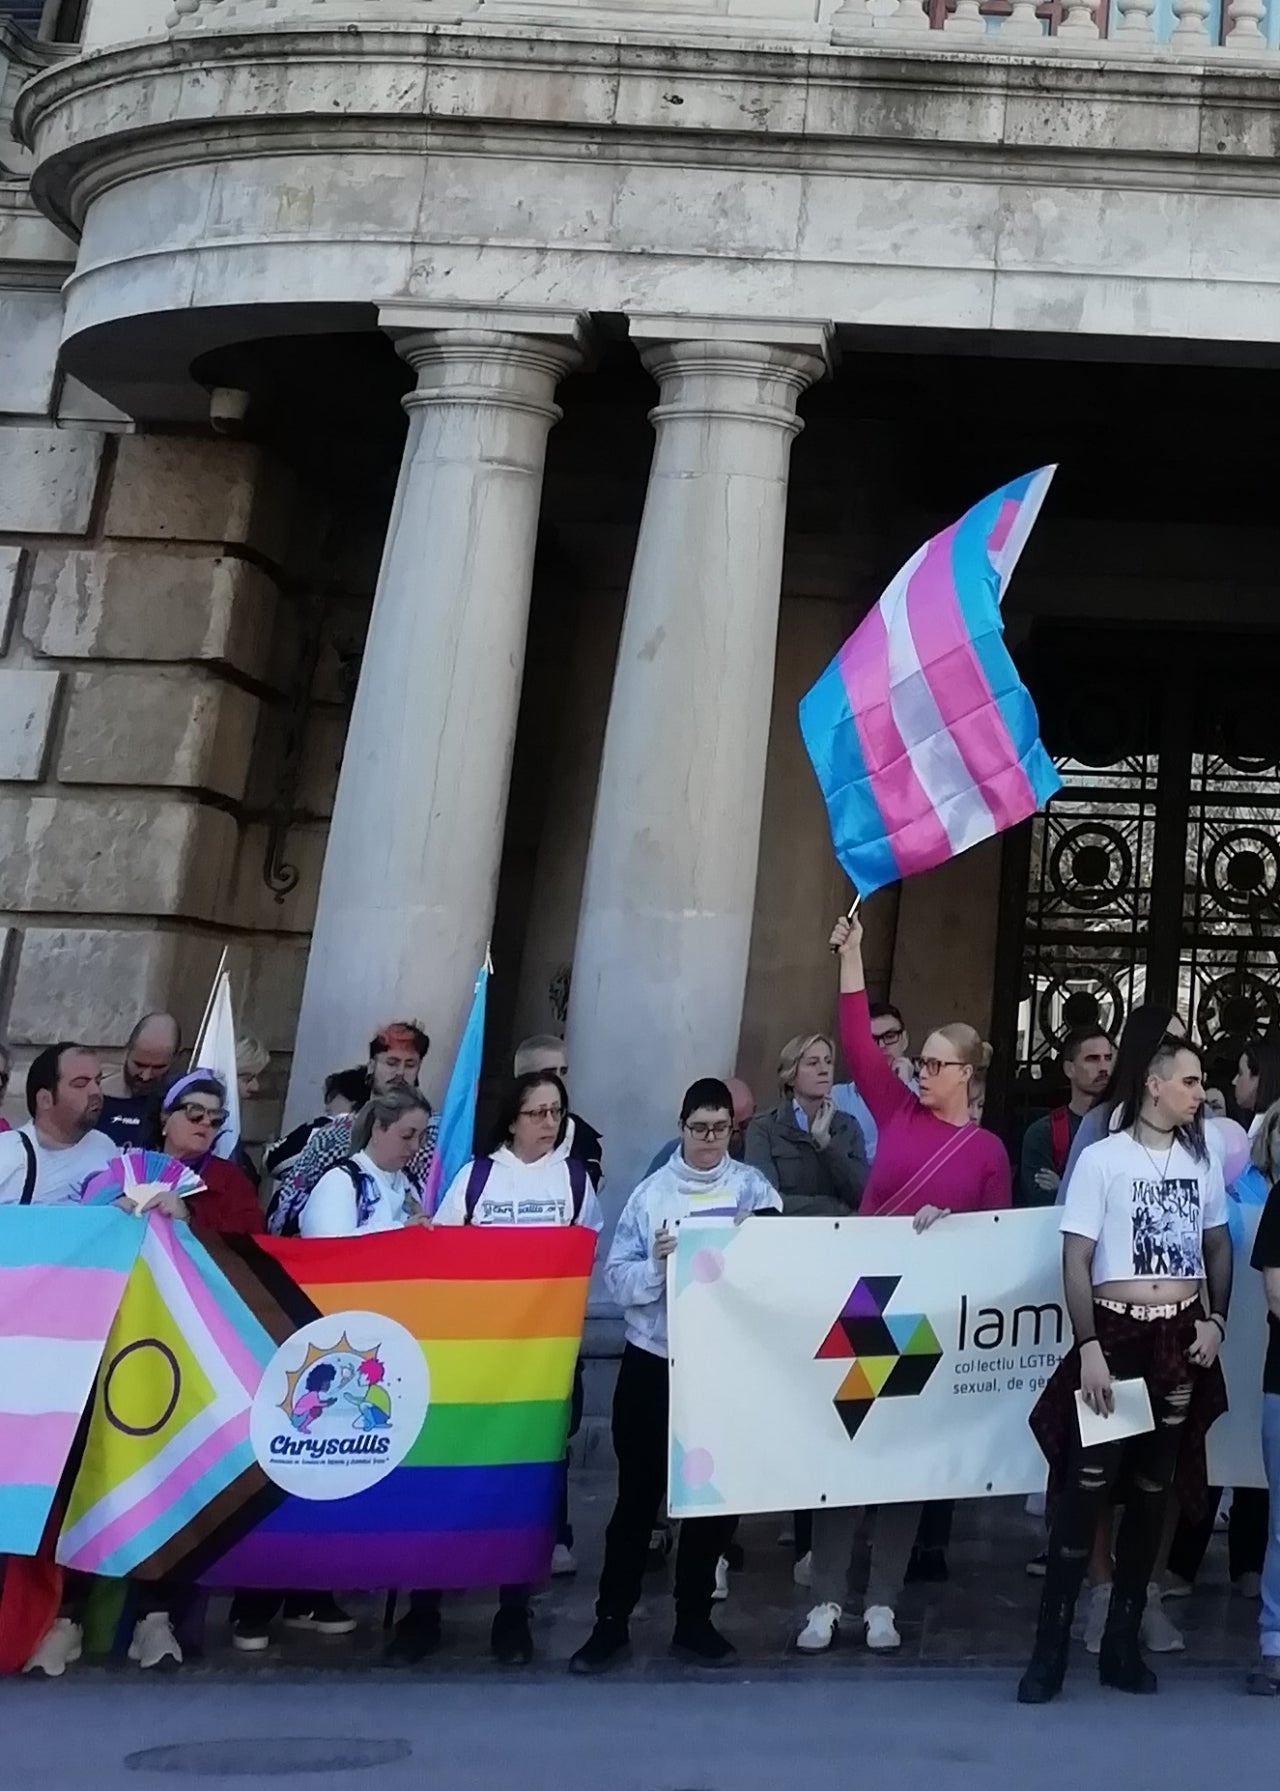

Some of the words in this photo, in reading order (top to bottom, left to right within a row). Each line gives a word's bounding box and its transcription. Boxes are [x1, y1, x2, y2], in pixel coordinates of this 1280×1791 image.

[958, 1294, 1063, 1351] lam
[953, 1377, 1001, 1395] sexual,
[1007, 1376, 1023, 1390] de
[1029, 1375, 1046, 1392] gè
[269, 1434, 391, 1458] Chrysallis
